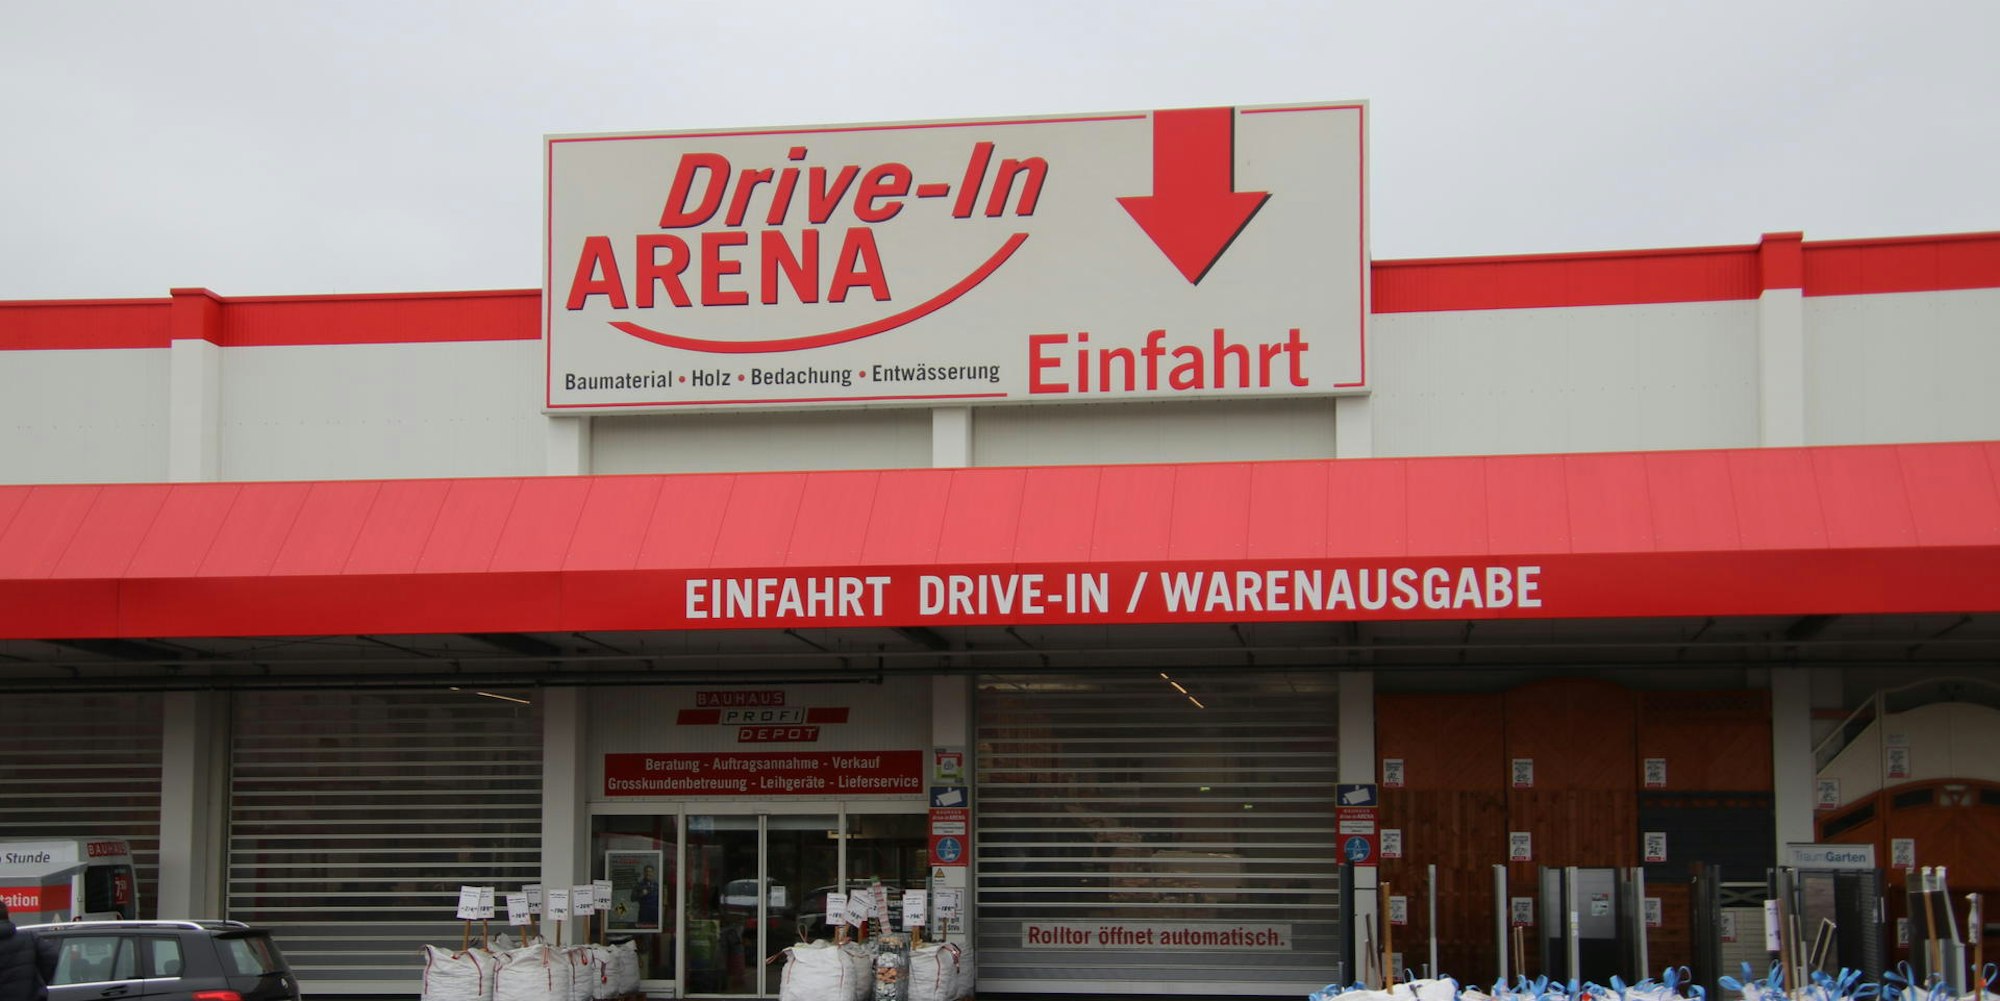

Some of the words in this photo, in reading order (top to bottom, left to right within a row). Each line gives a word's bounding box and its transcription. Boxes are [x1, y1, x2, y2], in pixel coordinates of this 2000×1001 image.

[659, 141, 1049, 228] Drive-In
[566, 227, 892, 311] ARENA
[1028, 328, 1310, 394] Einfahrt
[565, 370, 672, 391] Baumaterial
[691, 368, 731, 388] Holz
[751, 367, 852, 388] Bedachung
[872, 364, 1000, 384] Entwässerung
[685, 576, 891, 618] EINFAHRT
[919, 572, 1109, 616] DRIVE-IN
[1126, 571, 1149, 613] /
[1160, 566, 1542, 613] WARENAUSGABE
[697, 692, 783, 706] BAUHAUS
[727, 710, 800, 722] PROFI
[740, 728, 817, 741] DEPOT
[645, 757, 700, 773] Beratung
[712, 756, 819, 772] Auftragsannahme
[832, 755, 880, 769] Verkauf
[608, 776, 748, 792] Grosskundenbetreuung
[760, 775, 825, 791] Leihgeräte
[838, 775, 919, 789] Lieferservice
[6, 851, 51, 863] Stunde
[1793, 850, 1866, 863] TraumGarten
[1028, 926, 1091, 945] Rolltor
[1099, 927, 1153, 945] öffnet
[1160, 927, 1285, 947] automatisch.
